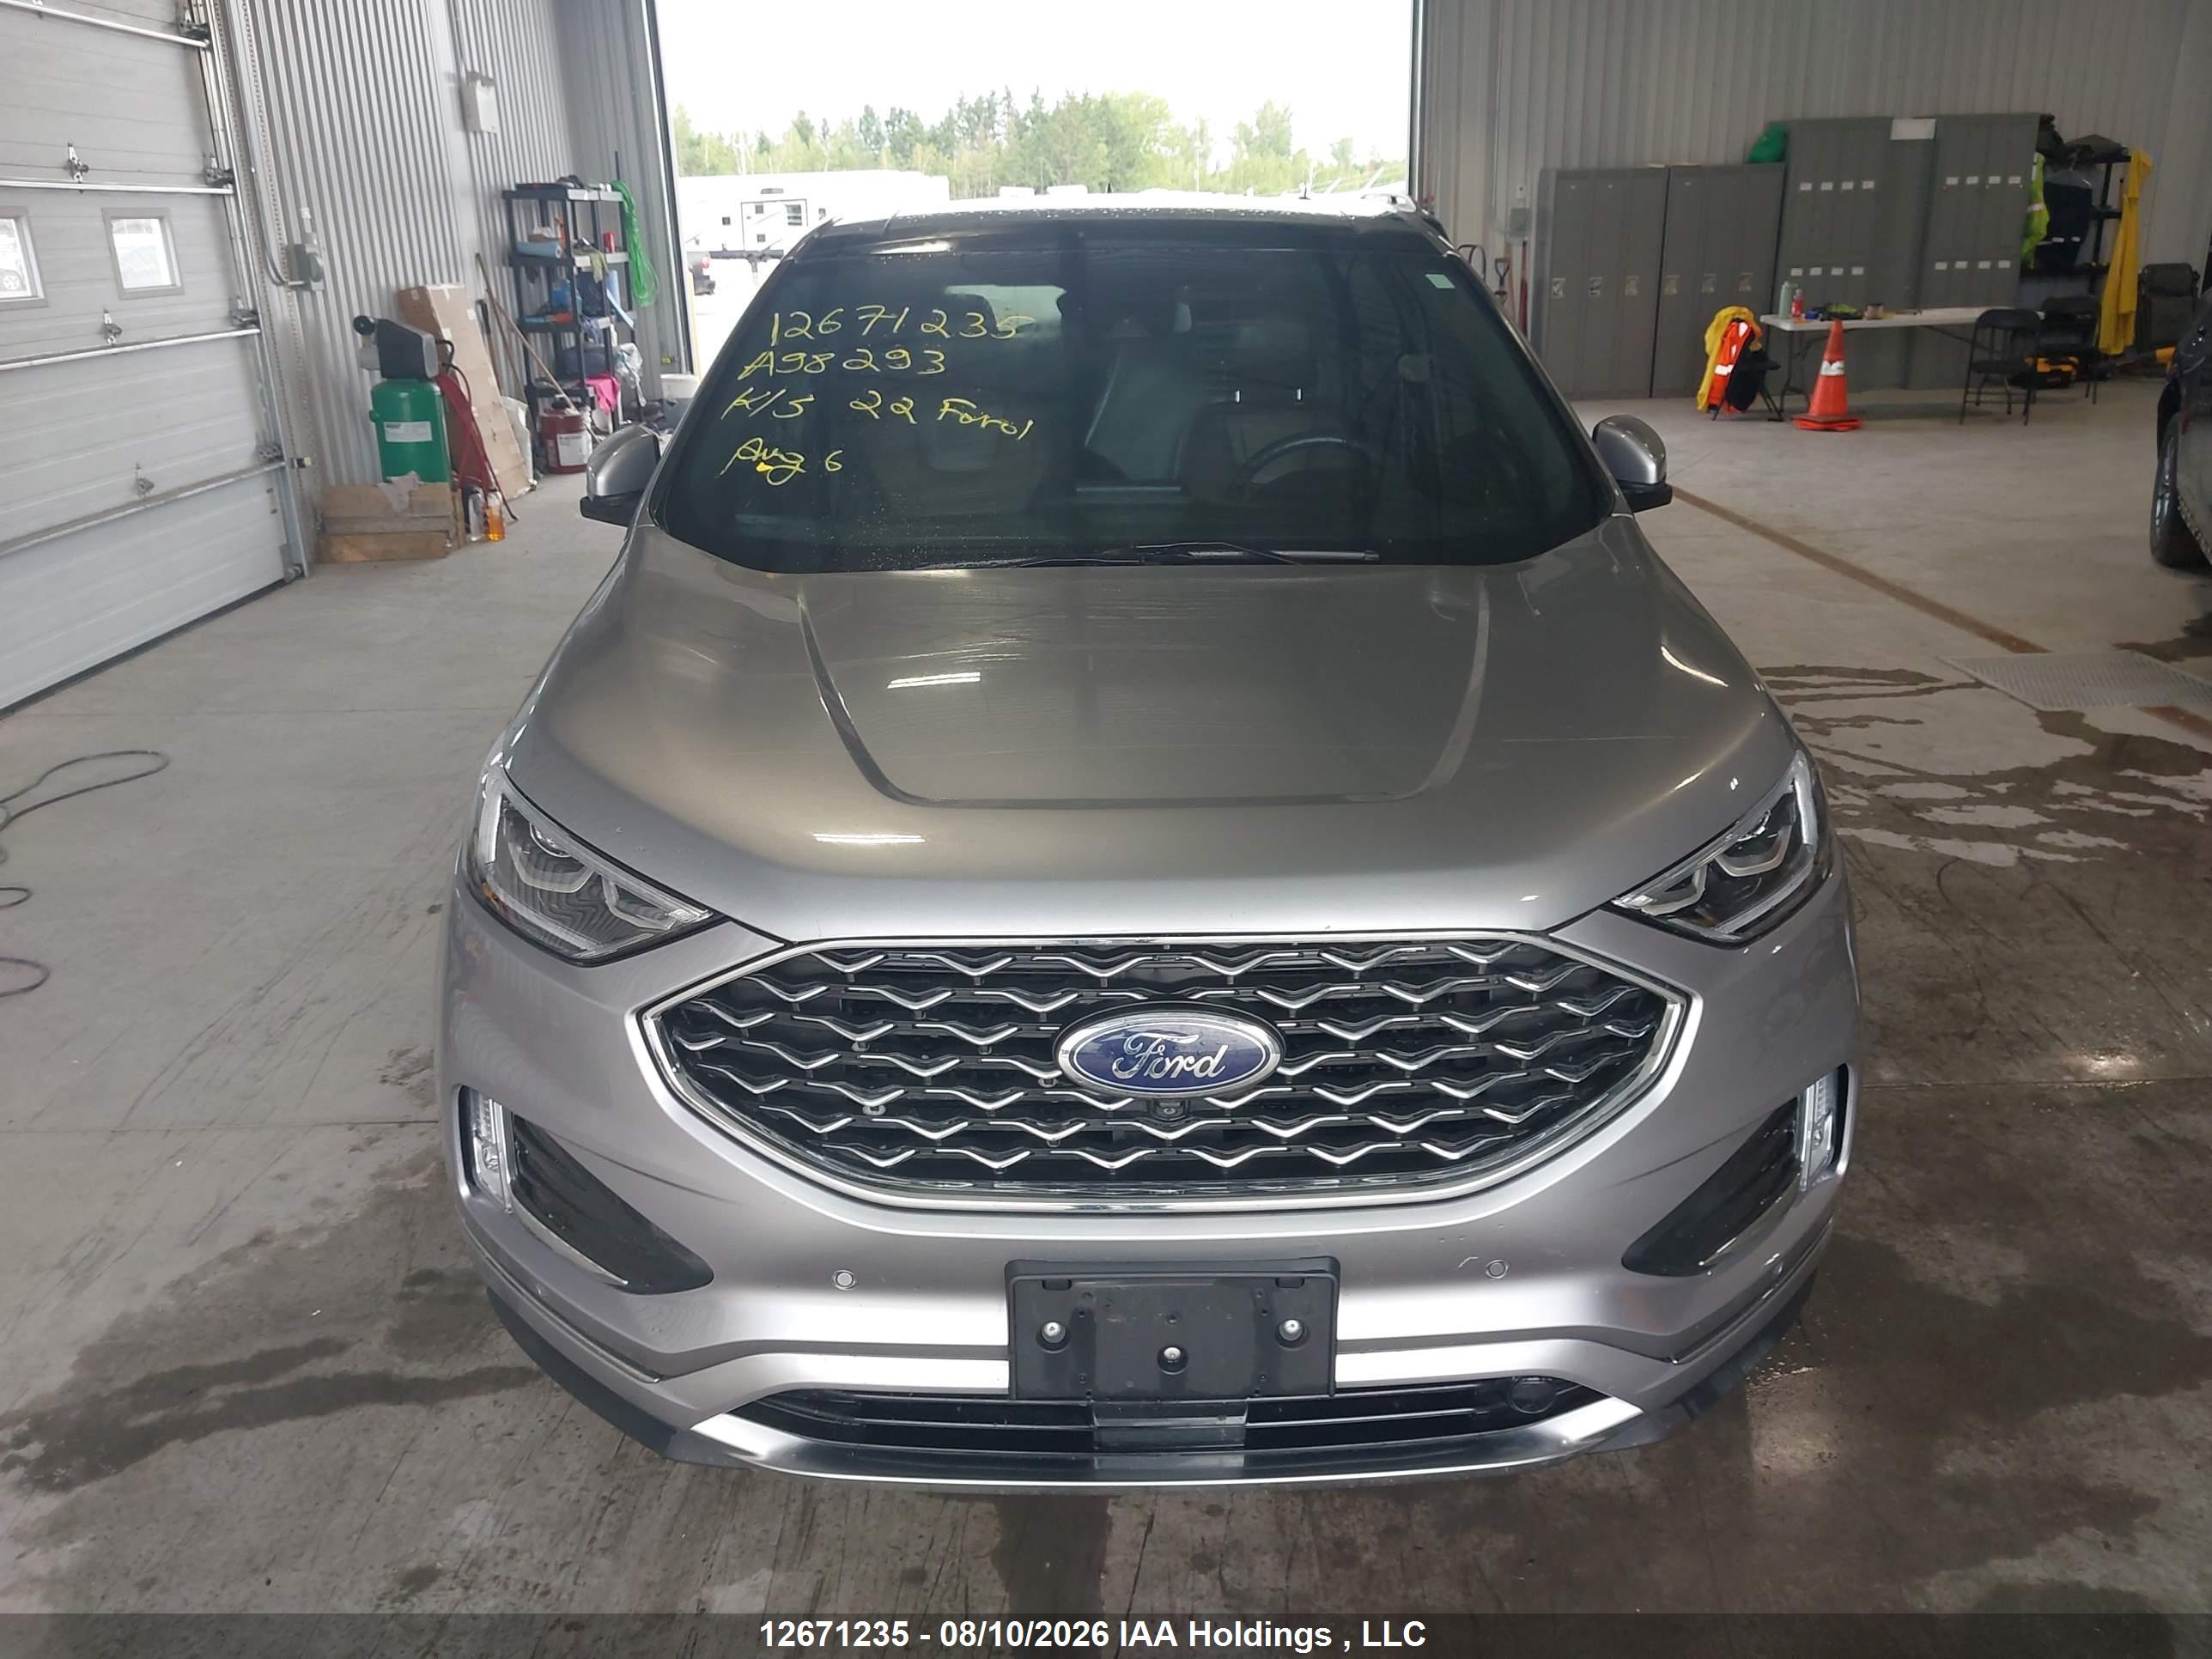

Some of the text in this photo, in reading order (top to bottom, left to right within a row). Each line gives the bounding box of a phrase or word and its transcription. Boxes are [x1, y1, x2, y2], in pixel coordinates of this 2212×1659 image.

[737, 349, 946, 380] A98293
[848, 390, 917, 424] 22
[823, 449, 845, 472] 6
[1112, 1032, 1230, 1079] Ford
